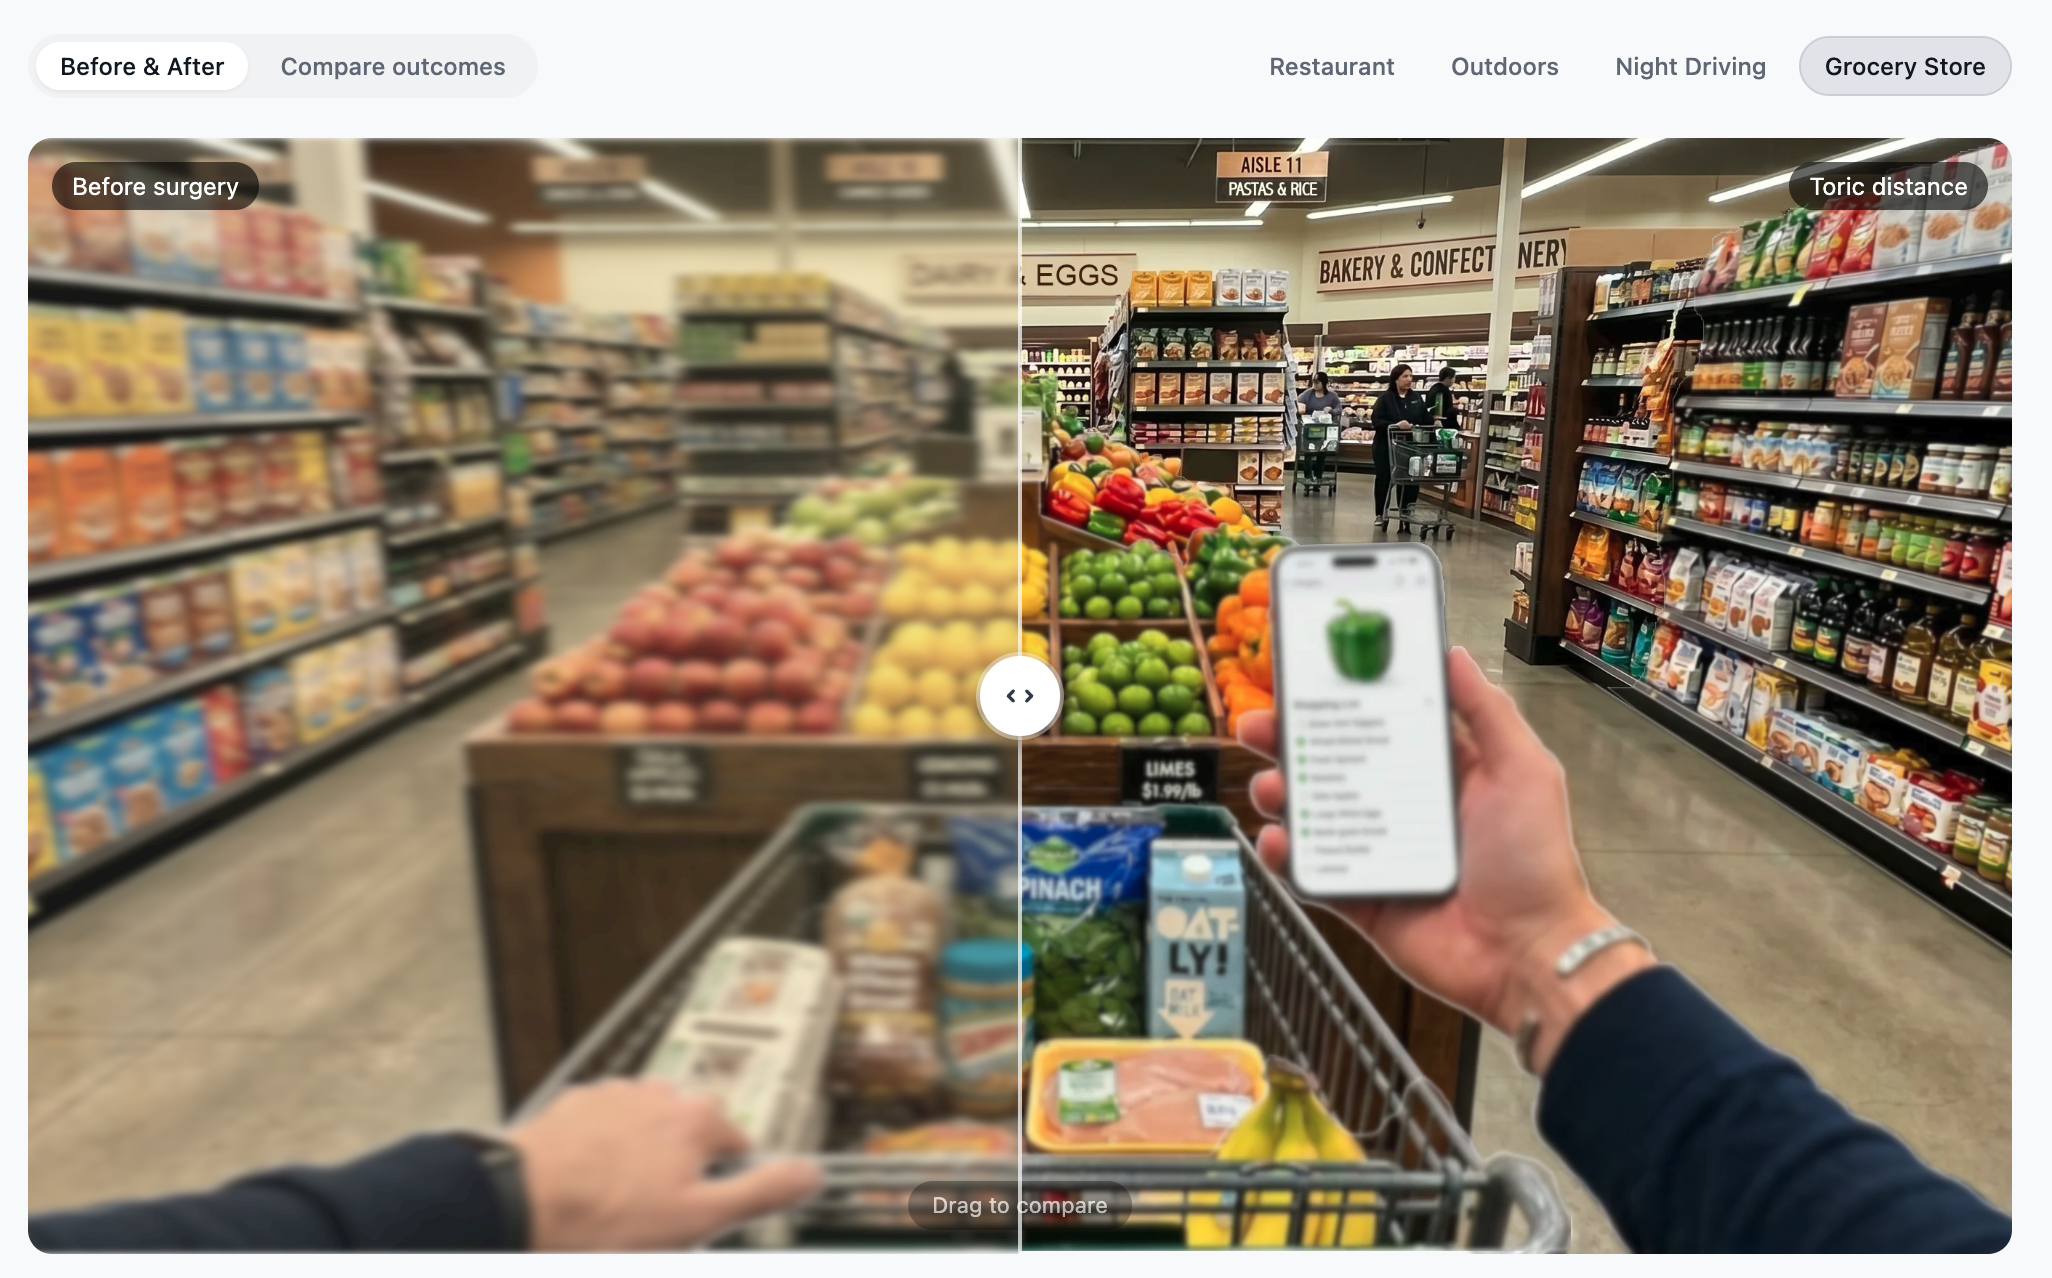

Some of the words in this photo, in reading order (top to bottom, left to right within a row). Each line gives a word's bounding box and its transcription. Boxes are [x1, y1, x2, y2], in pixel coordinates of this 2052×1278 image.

[1241, 157, 1282, 174] AISLE
[1286, 156, 1302, 174] 11
[1228, 181, 1274, 196] PASTAS
[1277, 181, 1287, 196] &
[1290, 181, 1318, 196] RICE
[1036, 263, 1119, 287] EGGS
[1319, 254, 1386, 285] BAKERY
[1390, 252, 1404, 279] &
[1145, 760, 1196, 778] LIMES
[1142, 780, 1203, 801] $1.99/lb
[1000, 873, 1102, 902] PINACH
[1169, 942, 1228, 977] LY!
